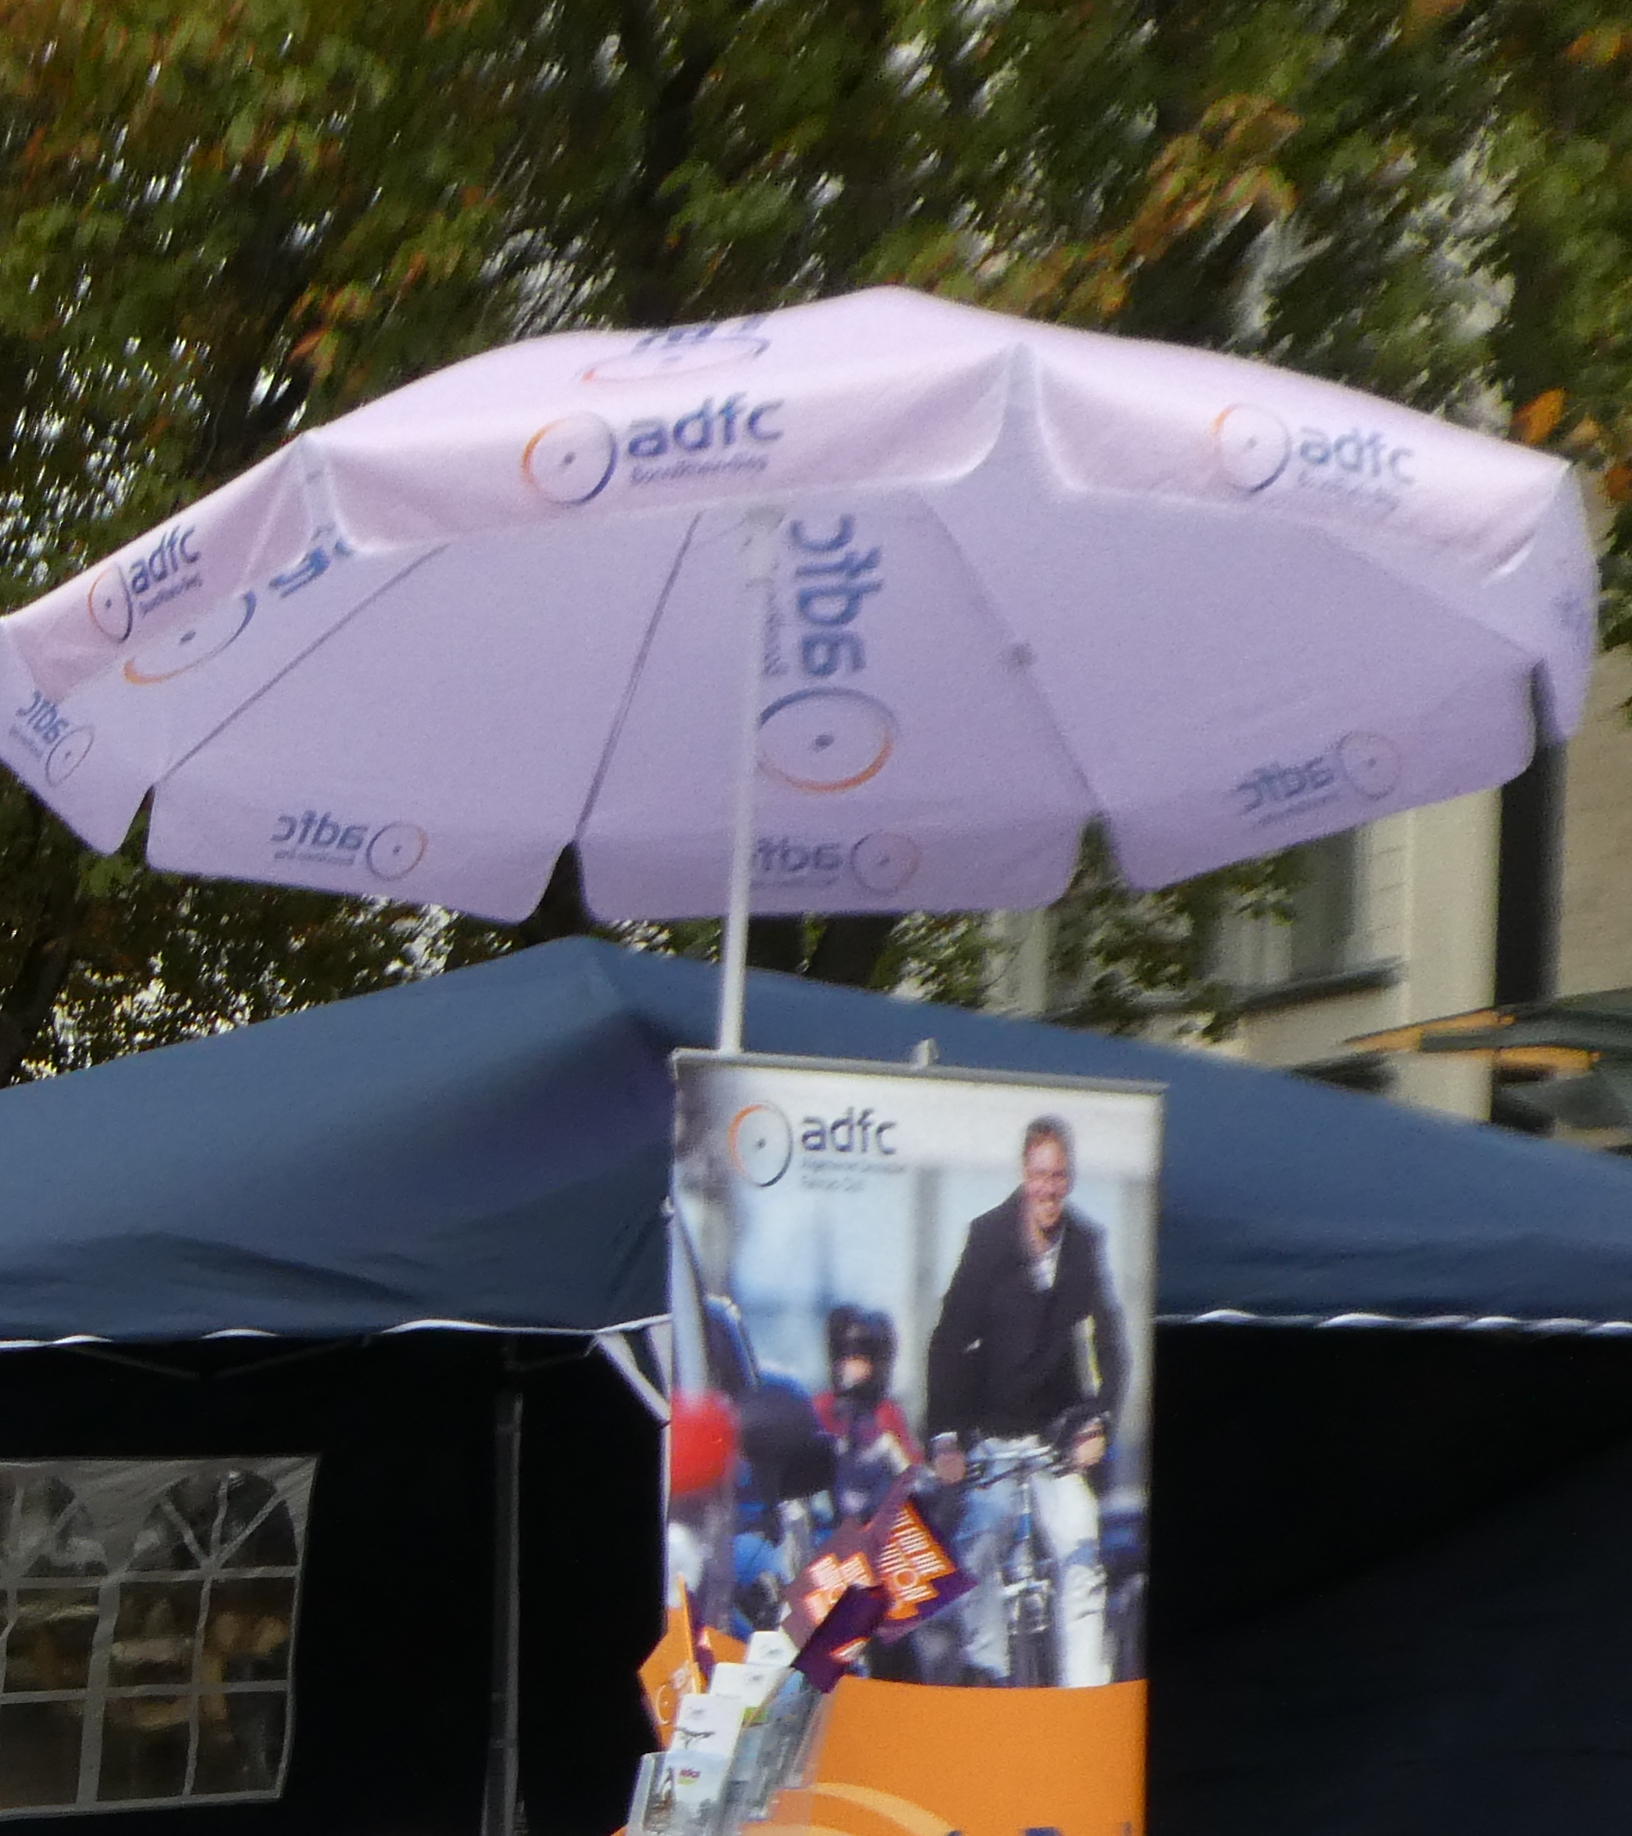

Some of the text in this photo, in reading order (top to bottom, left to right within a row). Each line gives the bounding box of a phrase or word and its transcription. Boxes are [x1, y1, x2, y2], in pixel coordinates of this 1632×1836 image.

[626, 393, 784, 459] adfc
[1297, 423, 1416, 486] adfc
[133, 523, 202, 596] adfc
[802, 1106, 897, 1155] adfc
